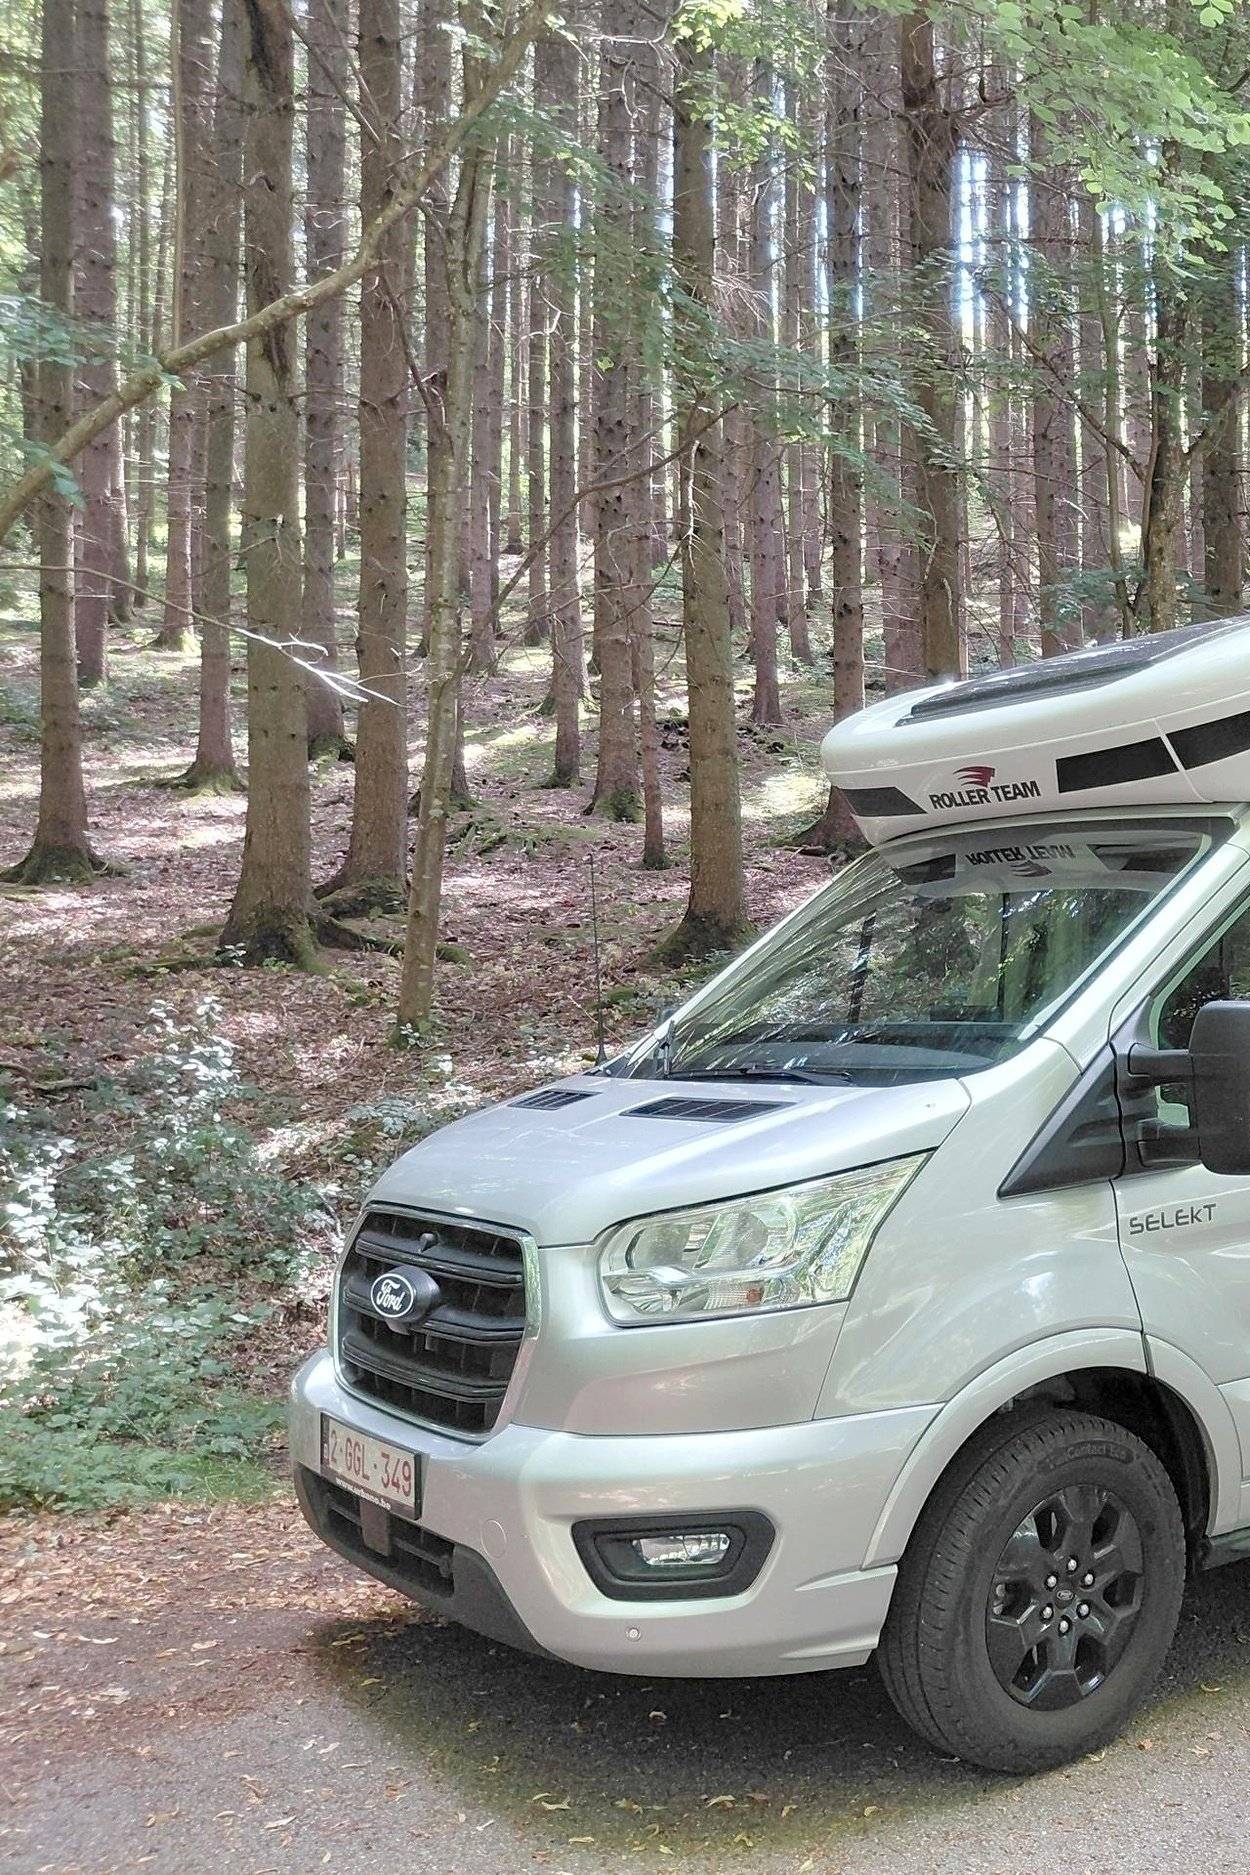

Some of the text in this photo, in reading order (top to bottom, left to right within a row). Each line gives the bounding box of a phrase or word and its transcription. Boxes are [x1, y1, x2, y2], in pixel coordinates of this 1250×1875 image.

[929, 780, 1041, 810] ROLLER TEAM
[1129, 1204, 1217, 1235] SELEKT
[375, 1279, 405, 1312] Ford
